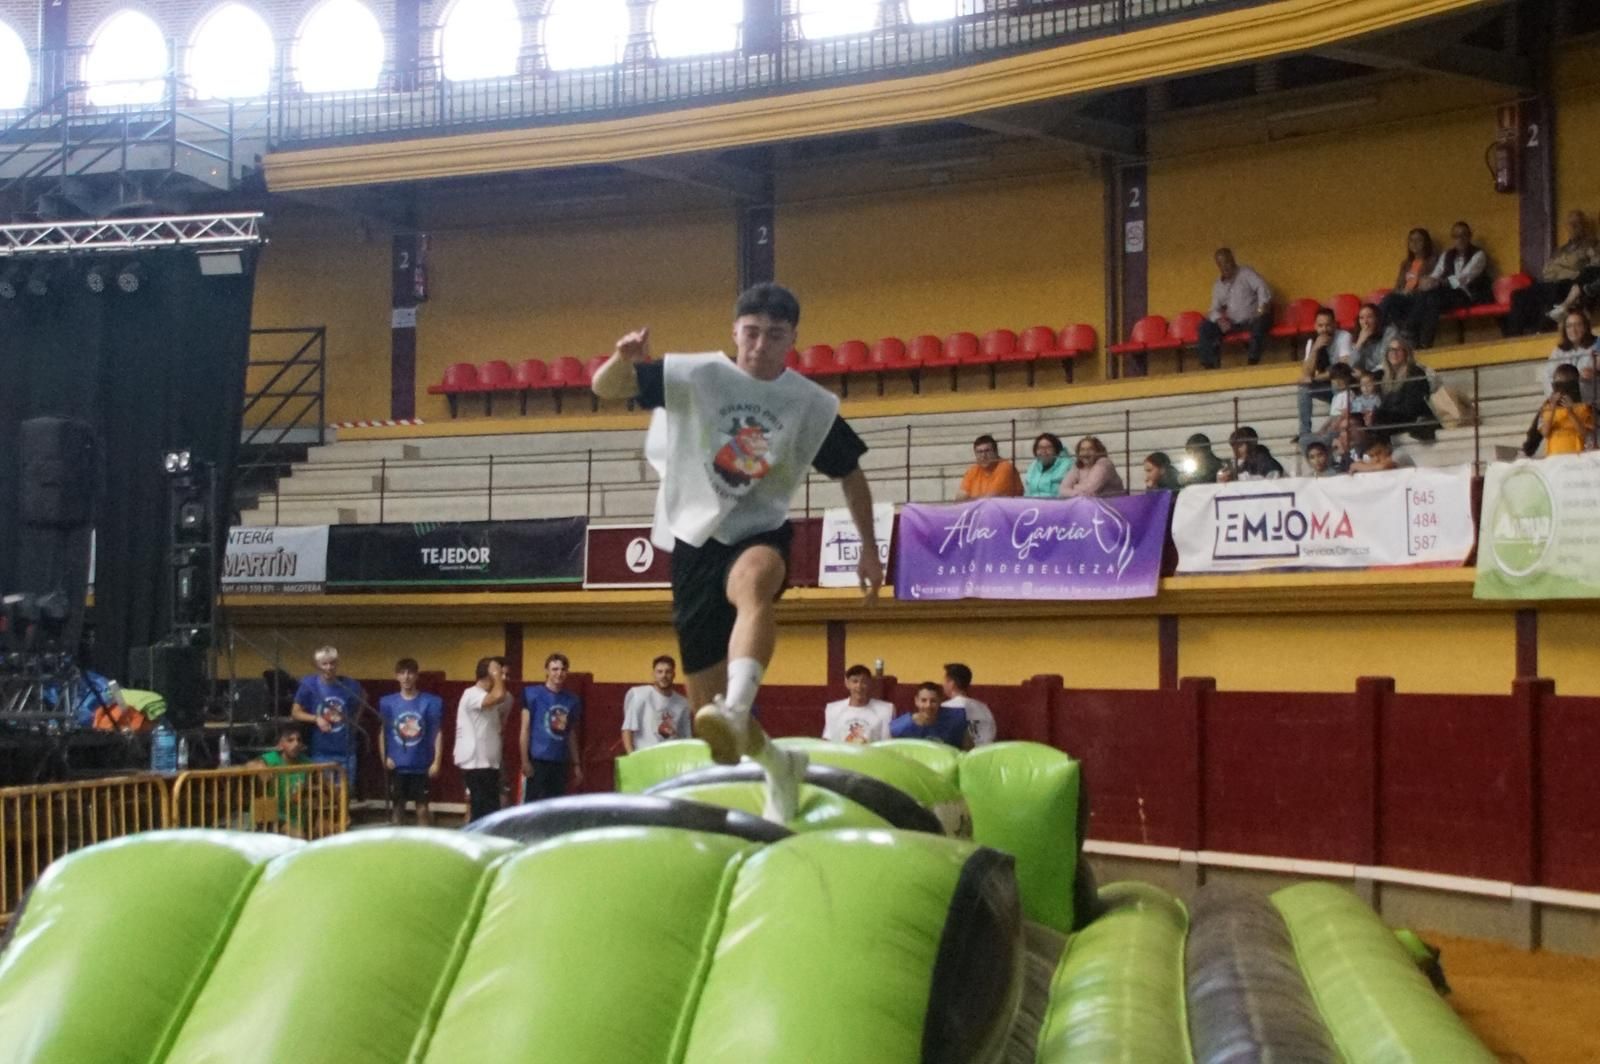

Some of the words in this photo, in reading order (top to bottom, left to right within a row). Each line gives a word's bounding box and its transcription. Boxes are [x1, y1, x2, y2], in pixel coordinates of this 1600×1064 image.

[1527, 123, 1539, 148] 2
[1129, 187, 1140, 208] 2
[757, 226, 769, 245] 2
[400, 252, 410, 269] 2
[1413, 489, 1436, 506] 645
[1225, 508, 1354, 543] EMJOMA
[1413, 512, 1439, 528] 484
[1414, 535, 1438, 551] 587
[420, 547, 491, 564] TEJEDOR
[632, 539, 648, 567] 2
